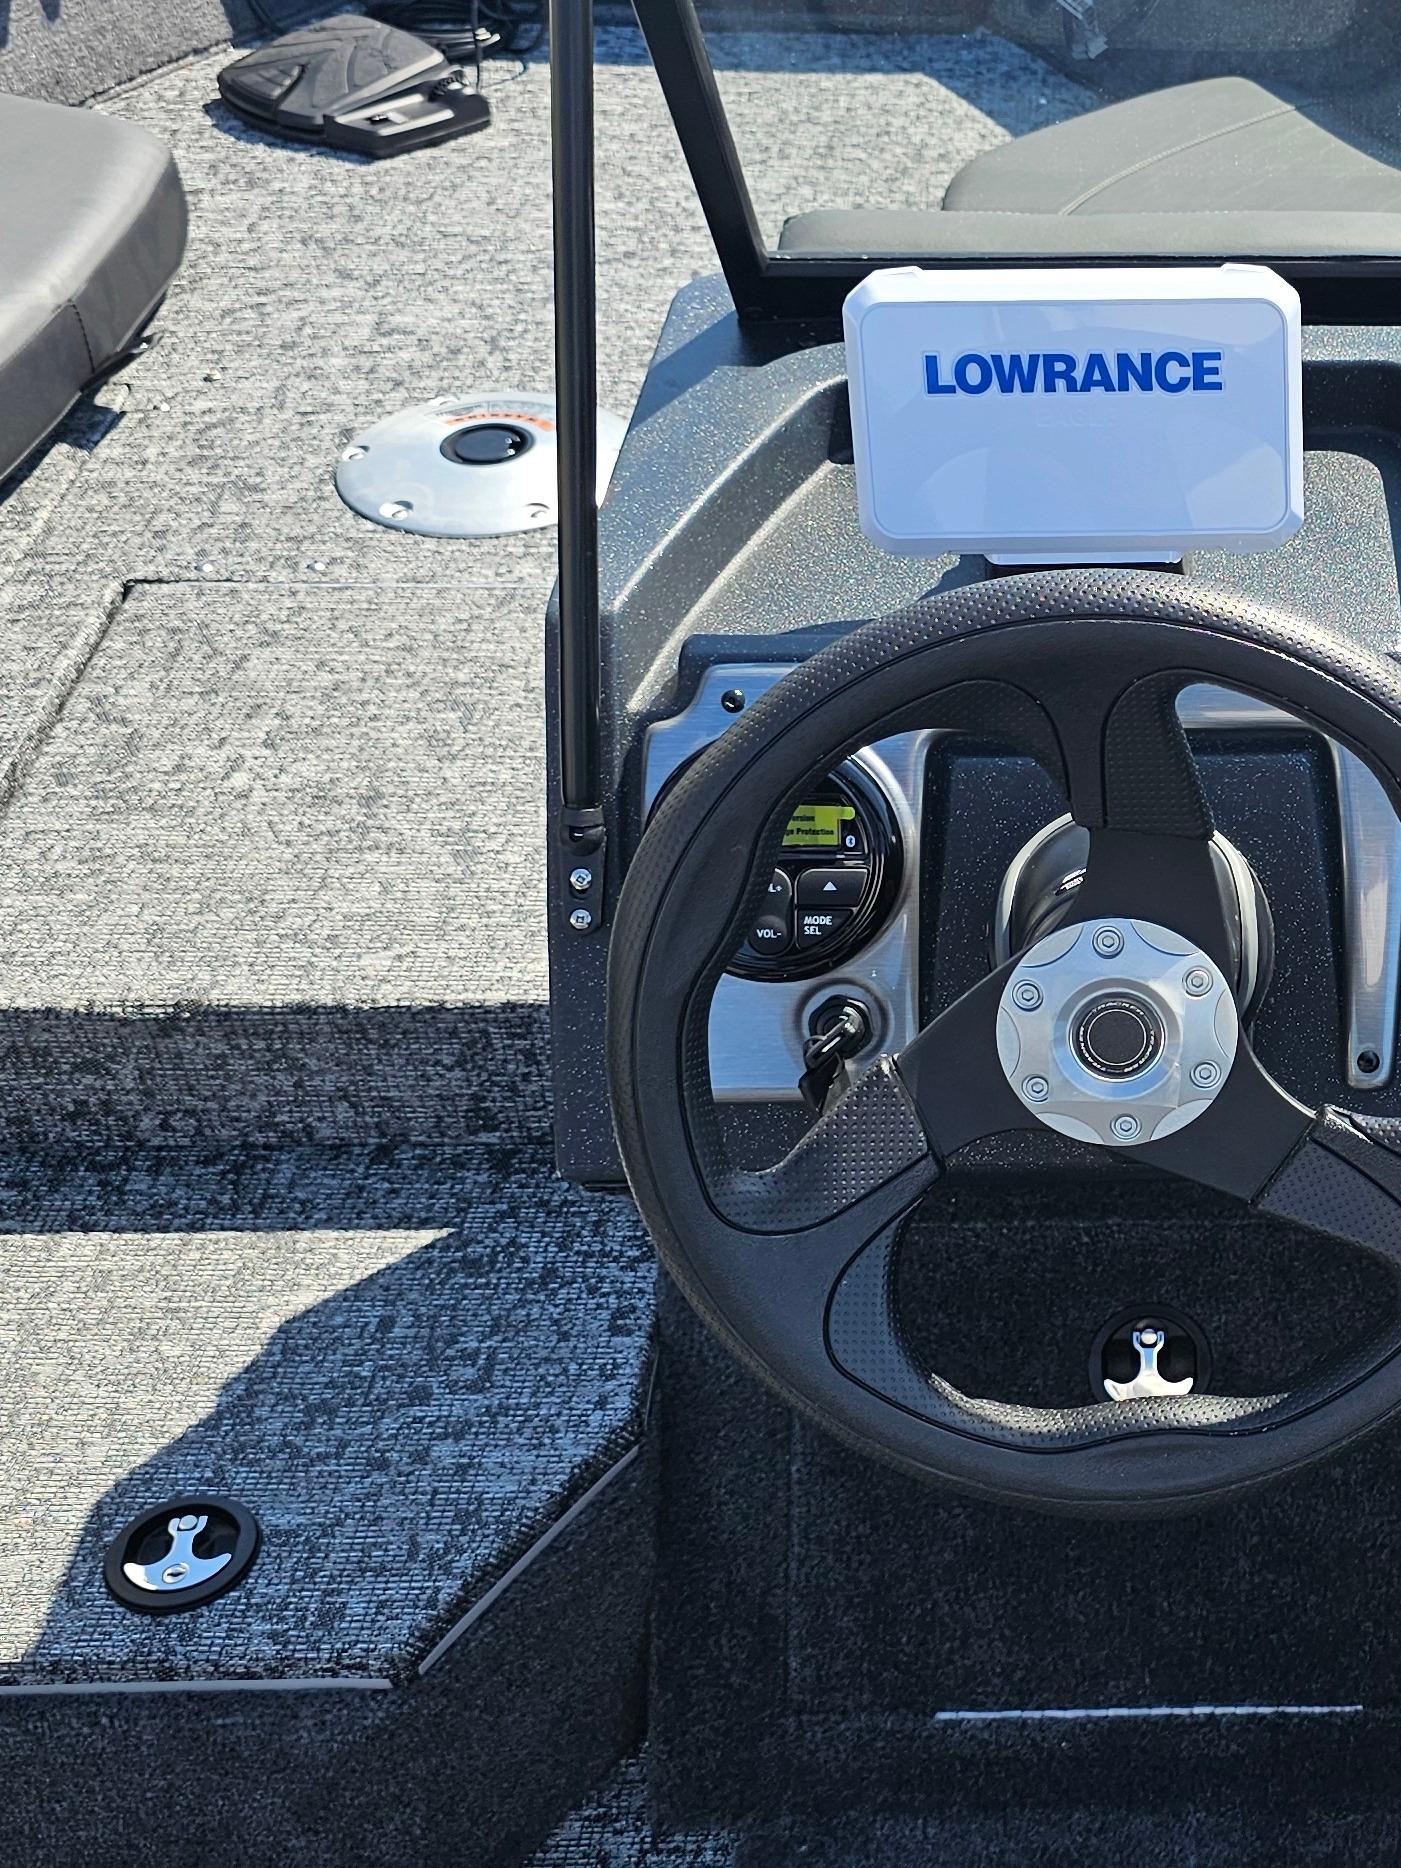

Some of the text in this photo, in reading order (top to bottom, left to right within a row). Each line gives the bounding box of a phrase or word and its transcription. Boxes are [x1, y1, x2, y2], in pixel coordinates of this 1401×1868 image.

[924, 351, 1224, 395] LOWRANCE
[803, 915, 833, 926] MODE
[756, 928, 782, 939] VOL-
[803, 925, 822, 935] SEL
